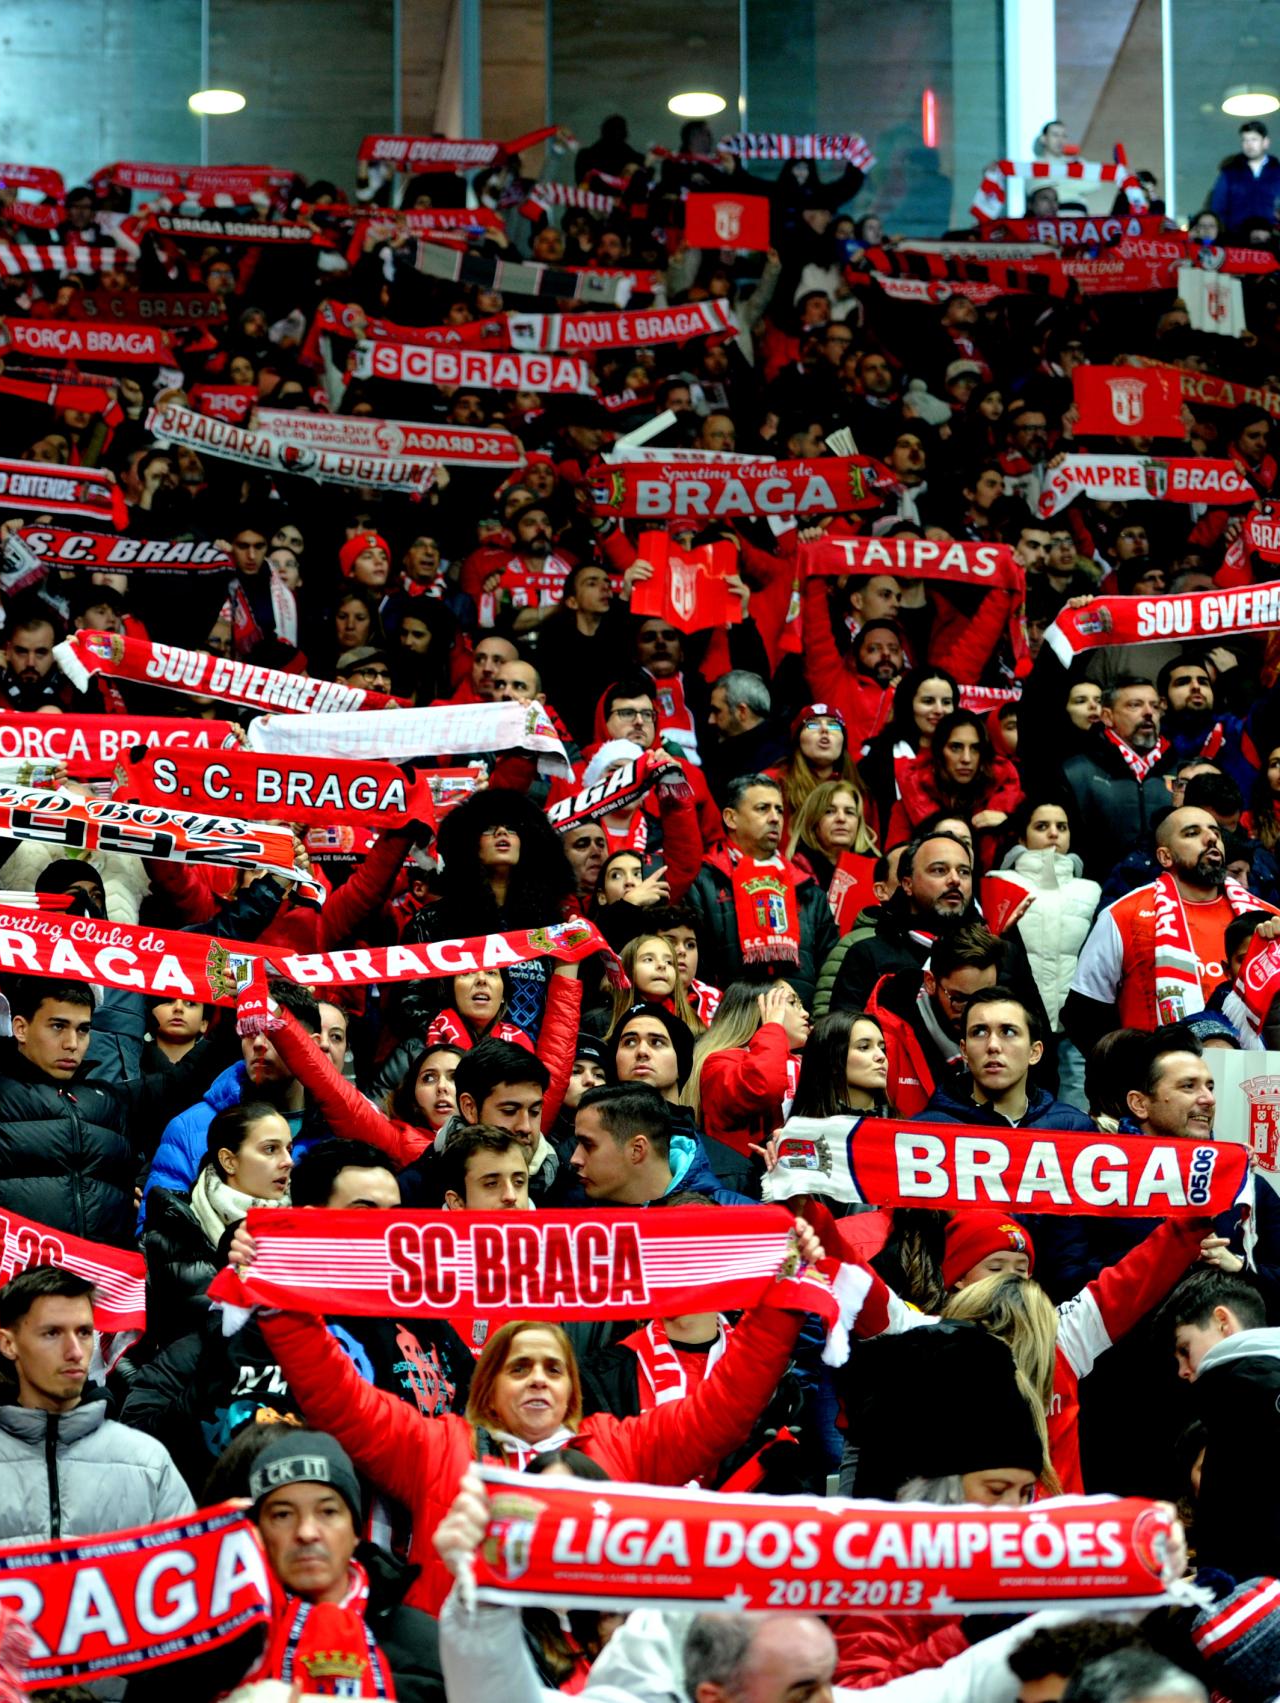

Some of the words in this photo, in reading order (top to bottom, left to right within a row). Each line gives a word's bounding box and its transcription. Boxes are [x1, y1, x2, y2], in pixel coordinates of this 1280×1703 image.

[174, 217, 223, 236] BRAGA
[225, 221, 280, 239] SOMOS
[1035, 220, 1141, 246] BRAGA
[138, 299, 222, 319] BRAGA
[13, 326, 80, 354] FORÇA
[86, 332, 156, 355] BRAGA
[563, 323, 613, 347] AQUI
[633, 312, 703, 340] BRAGA
[8, 474, 80, 502] ENTENDE
[635, 476, 838, 516] BRAGA
[24, 532, 95, 561] S.C.
[832, 539, 1000, 577] TAIPAS
[1137, 599, 1193, 638] SOU
[146, 642, 209, 688] SOU
[209, 656, 369, 712] GVERREIRO
[255, 768, 406, 814] BRAGA
[69, 920, 133, 948] Clube
[138, 931, 166, 954] de
[282, 934, 526, 984] BRAGA
[895, 1131, 1189, 1208] BRAGA
[386, 1223, 458, 1309] SC
[469, 1221, 650, 1309] BRAGA
[77, 1538, 139, 1562] SPORTING
[140, 1527, 182, 1549] CLUBE
[704, 1520, 821, 1570] DOS
[830, 1512, 1127, 1570] CAMPEÕES
[767, 1578, 924, 1606] 2012-2013
[87, 1649, 144, 1672] SPORTING
